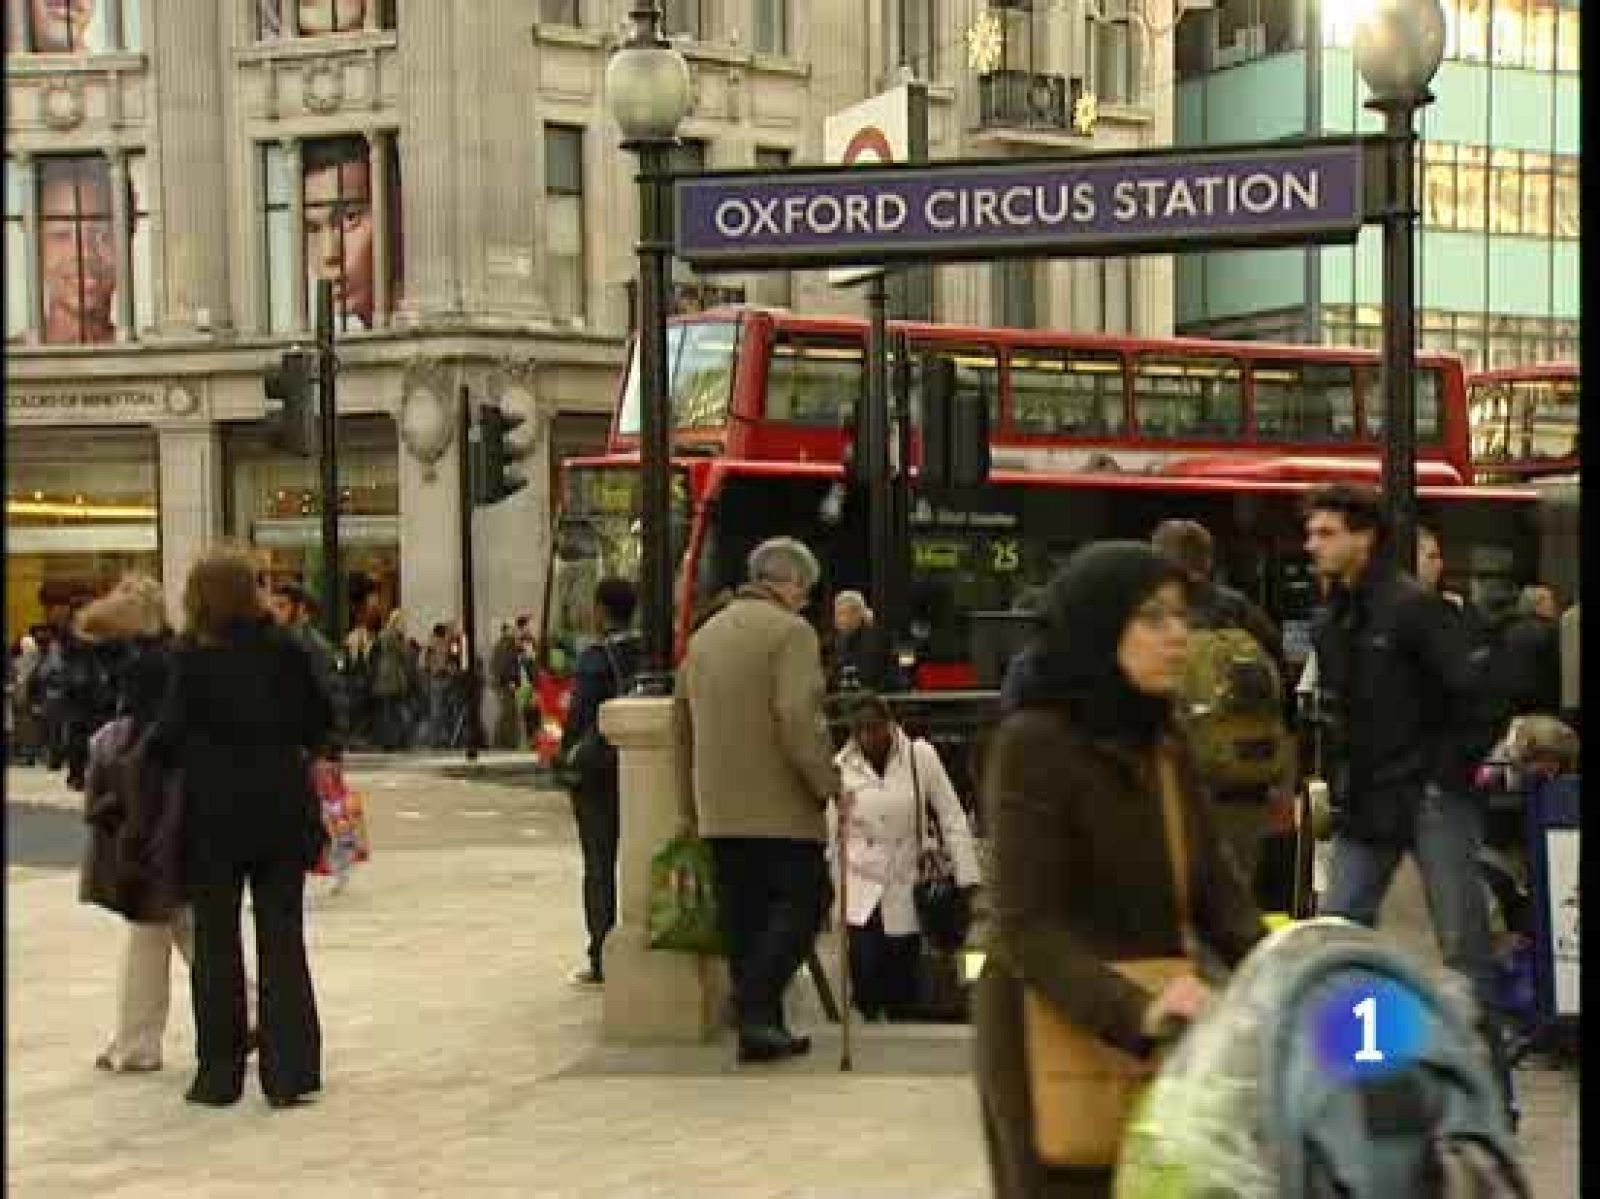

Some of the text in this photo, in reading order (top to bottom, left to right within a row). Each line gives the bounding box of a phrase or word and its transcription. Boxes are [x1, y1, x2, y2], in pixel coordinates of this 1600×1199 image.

[714, 168, 1320, 238] OXFORD CIRCUS STATION
